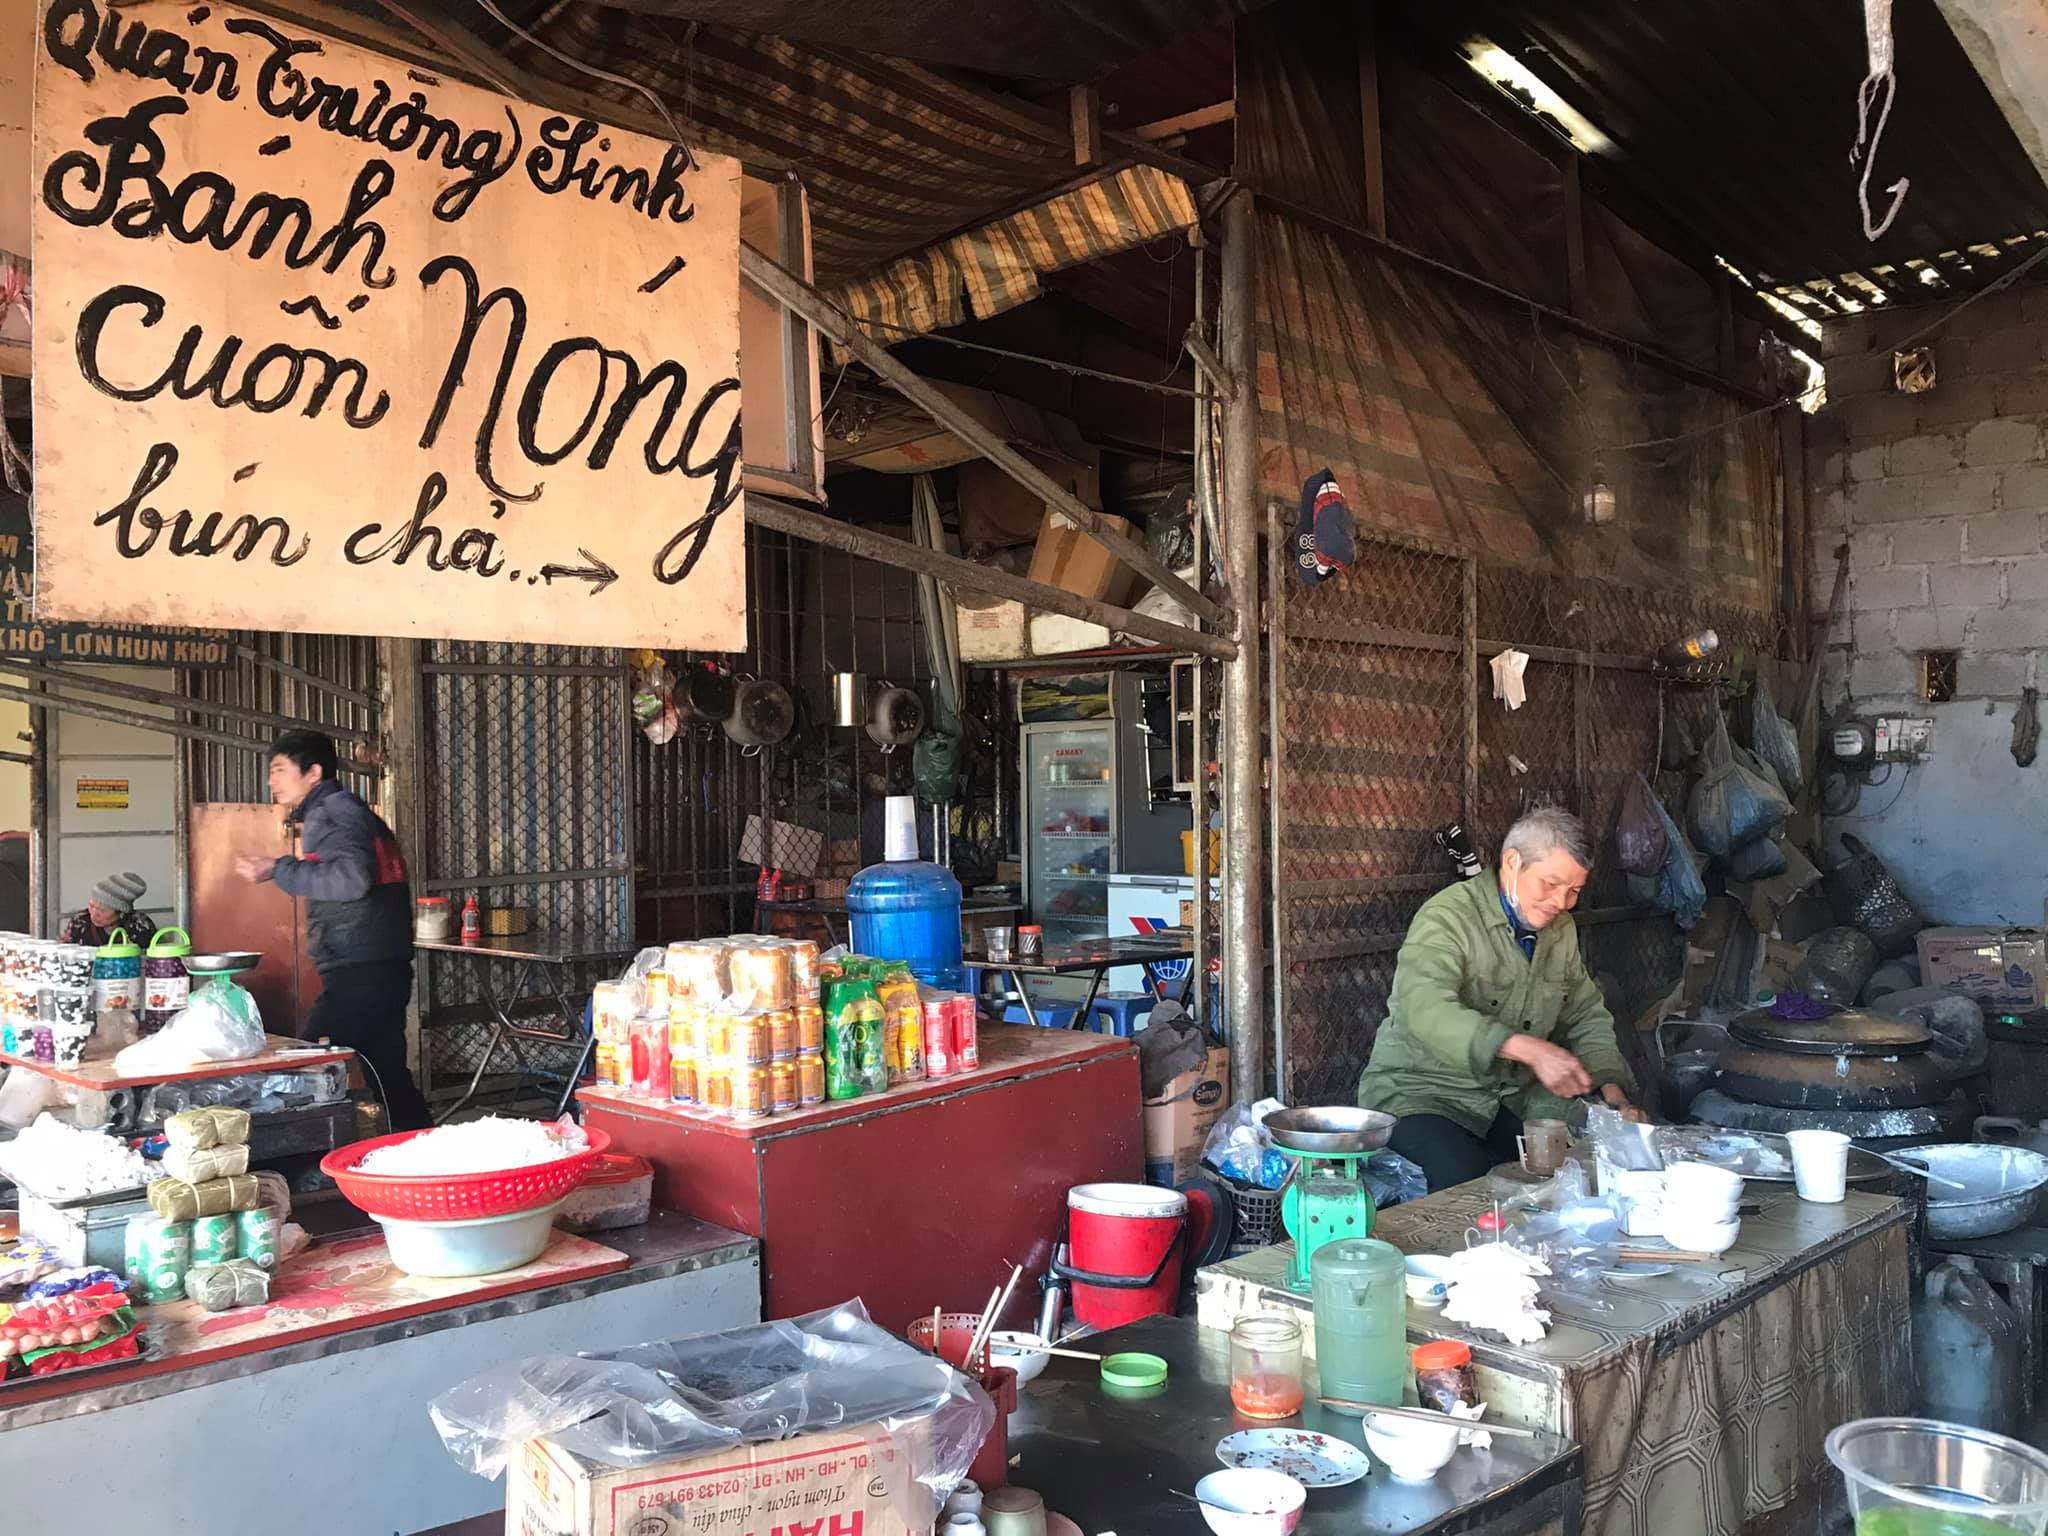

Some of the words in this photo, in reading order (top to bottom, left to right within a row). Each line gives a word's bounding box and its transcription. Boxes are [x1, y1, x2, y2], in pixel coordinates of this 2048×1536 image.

[44, 0, 239, 101] Quán
[526, 116, 695, 223] Sinh
[43, 96, 397, 289] Bánh
[95, 443, 312, 567] bún
[117, 636, 168, 661] HUN
[669, 1487, 695, 1504] 991
[699, 1479, 740, 1499] 02433
[767, 1490, 801, 1513] ngon
